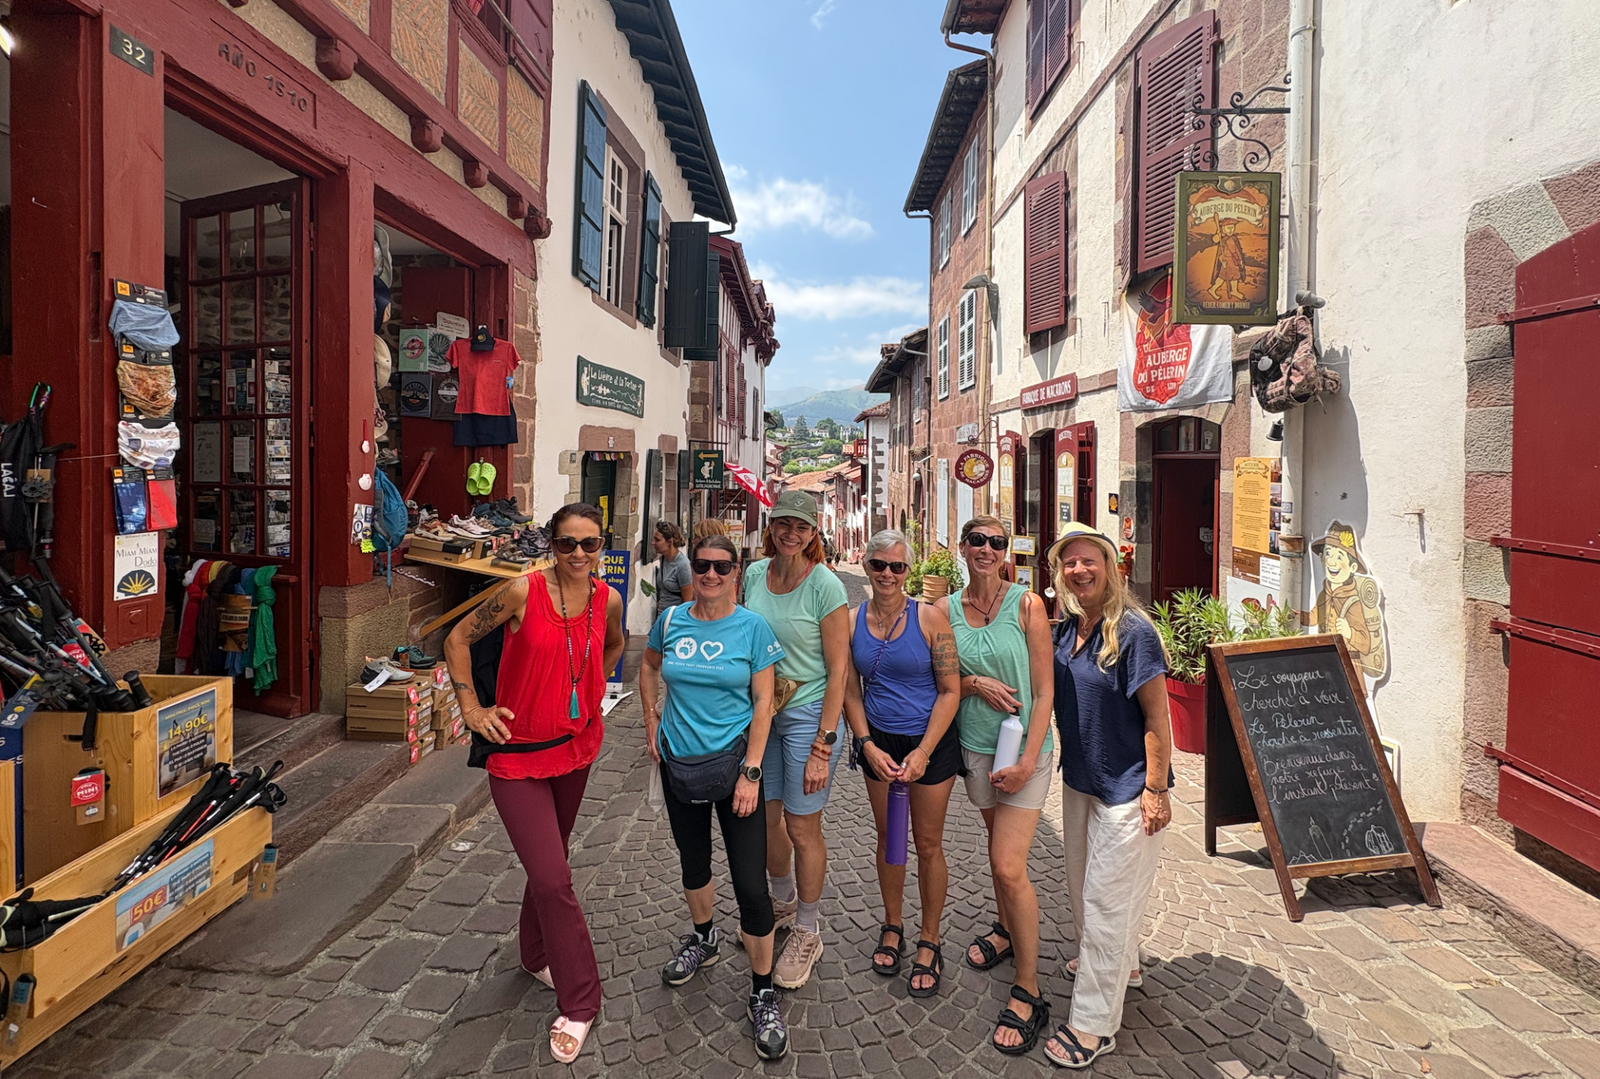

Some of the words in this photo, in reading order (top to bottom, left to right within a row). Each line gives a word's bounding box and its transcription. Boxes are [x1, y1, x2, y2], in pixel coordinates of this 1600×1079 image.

[121, 38, 146, 65] 32
[218, 41, 256, 78] AÑO
[264, 74, 308, 112] 1510
[1200, 203, 1225, 216] AUBERGE
[1225, 203, 1233, 213] DU
[1146, 347, 1188, 368] AUBERGE
[591, 366, 597, 379] Le
[1137, 371, 1148, 384] DU
[1022, 389, 1039, 405] FABRIQUE
[1040, 387, 1046, 401] DE
[1046, 380, 1071, 399] MACARONS
[959, 462, 965, 470] LA
[963, 453, 990, 468] FABRIQUE
[965, 470, 990, 484] MACARONS
[604, 555, 624, 565] QUE
[608, 577, 625, 585] shop
[1236, 665, 1269, 689] Le
[1271, 669, 1325, 698] voyageur
[1243, 690, 1295, 712] cherche
[168, 713, 208, 740] 14.90€
[1248, 717, 1268, 736] Le
[1256, 731, 1297, 749] cherche
[1261, 754, 1325, 777] Bienvenue
[1270, 770, 1301, 786] notre
[1305, 766, 1345, 790] refuge
[1350, 760, 1368, 772] de
[77, 785, 98, 797] MINI
[133, 889, 164, 922] 50€
